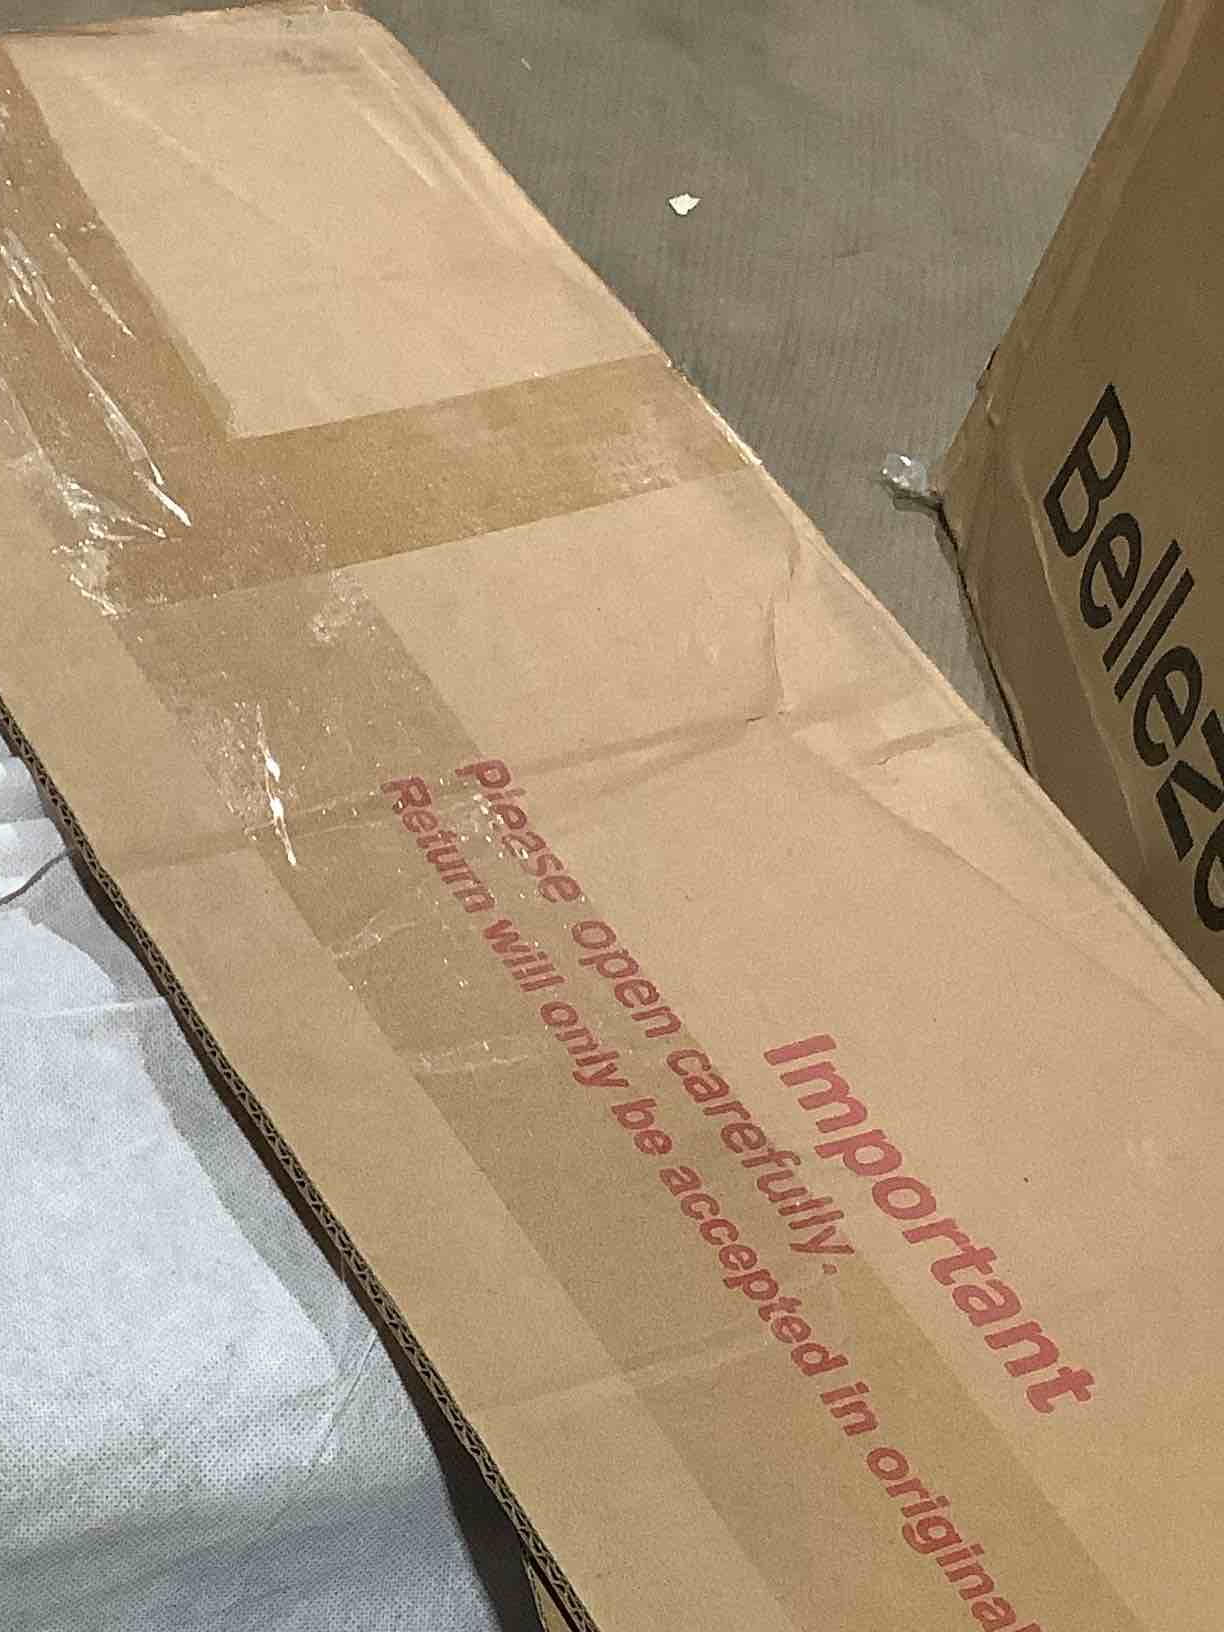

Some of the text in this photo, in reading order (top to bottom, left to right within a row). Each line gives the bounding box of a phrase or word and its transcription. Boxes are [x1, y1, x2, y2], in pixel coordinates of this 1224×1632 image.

[380, 775, 499, 916] Return
[485, 917, 565, 993] will
[540, 999, 629, 1090] only
[611, 1099, 674, 1155] be
[660, 1165, 848, 1378] accepted
[822, 1381, 880, 1437] in
[456, 758, 854, 1274] Please open carefully.
[764, 1034, 1095, 1414] Important
